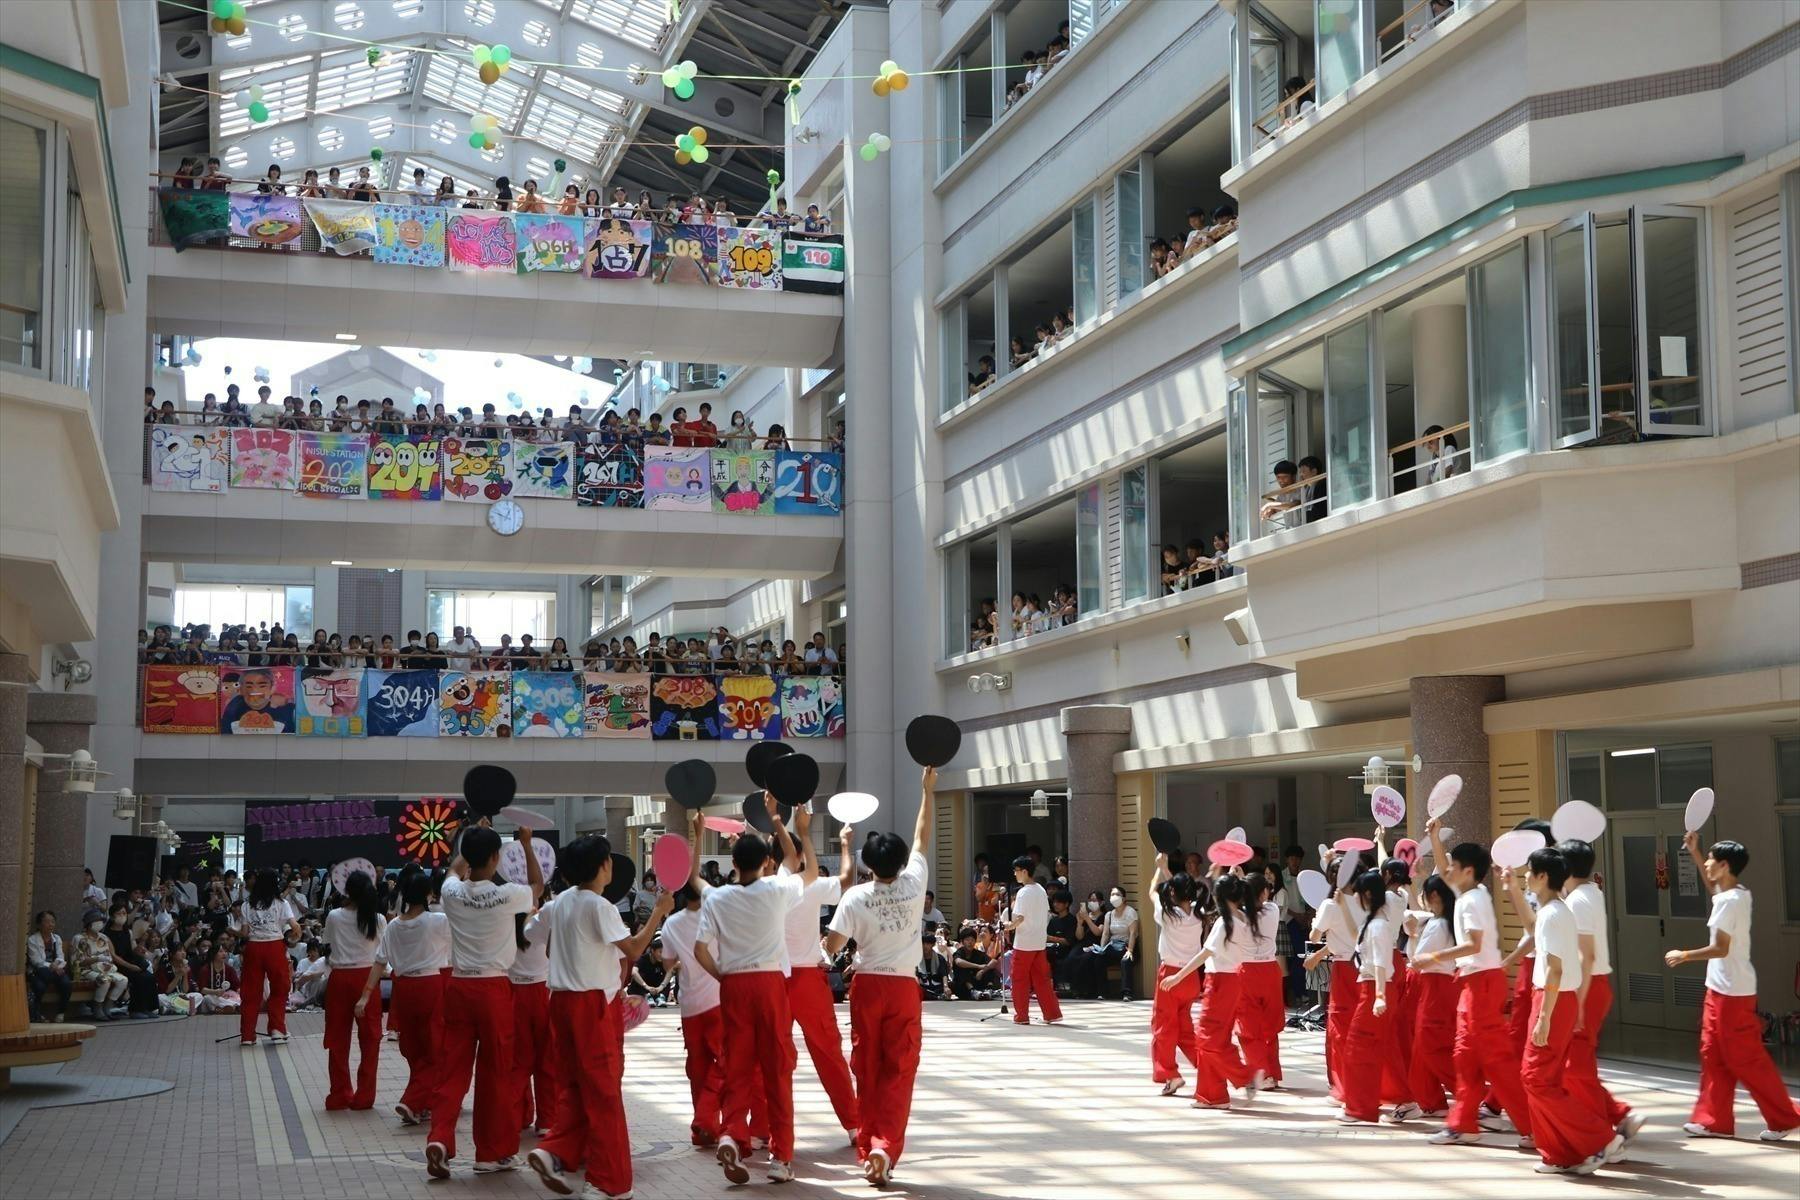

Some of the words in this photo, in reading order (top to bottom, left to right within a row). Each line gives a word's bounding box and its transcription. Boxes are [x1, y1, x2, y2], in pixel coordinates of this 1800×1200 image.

[664, 237, 703, 261] 108
[728, 245, 774, 275] 109
[232, 428, 294, 455] 202
[331, 448, 364, 459] STATION
[305, 459, 354, 487] 203
[530, 687, 575, 712] 306
[663, 676, 705, 696] 308
[440, 708, 486, 735] 305
[722, 701, 776, 728] 309
